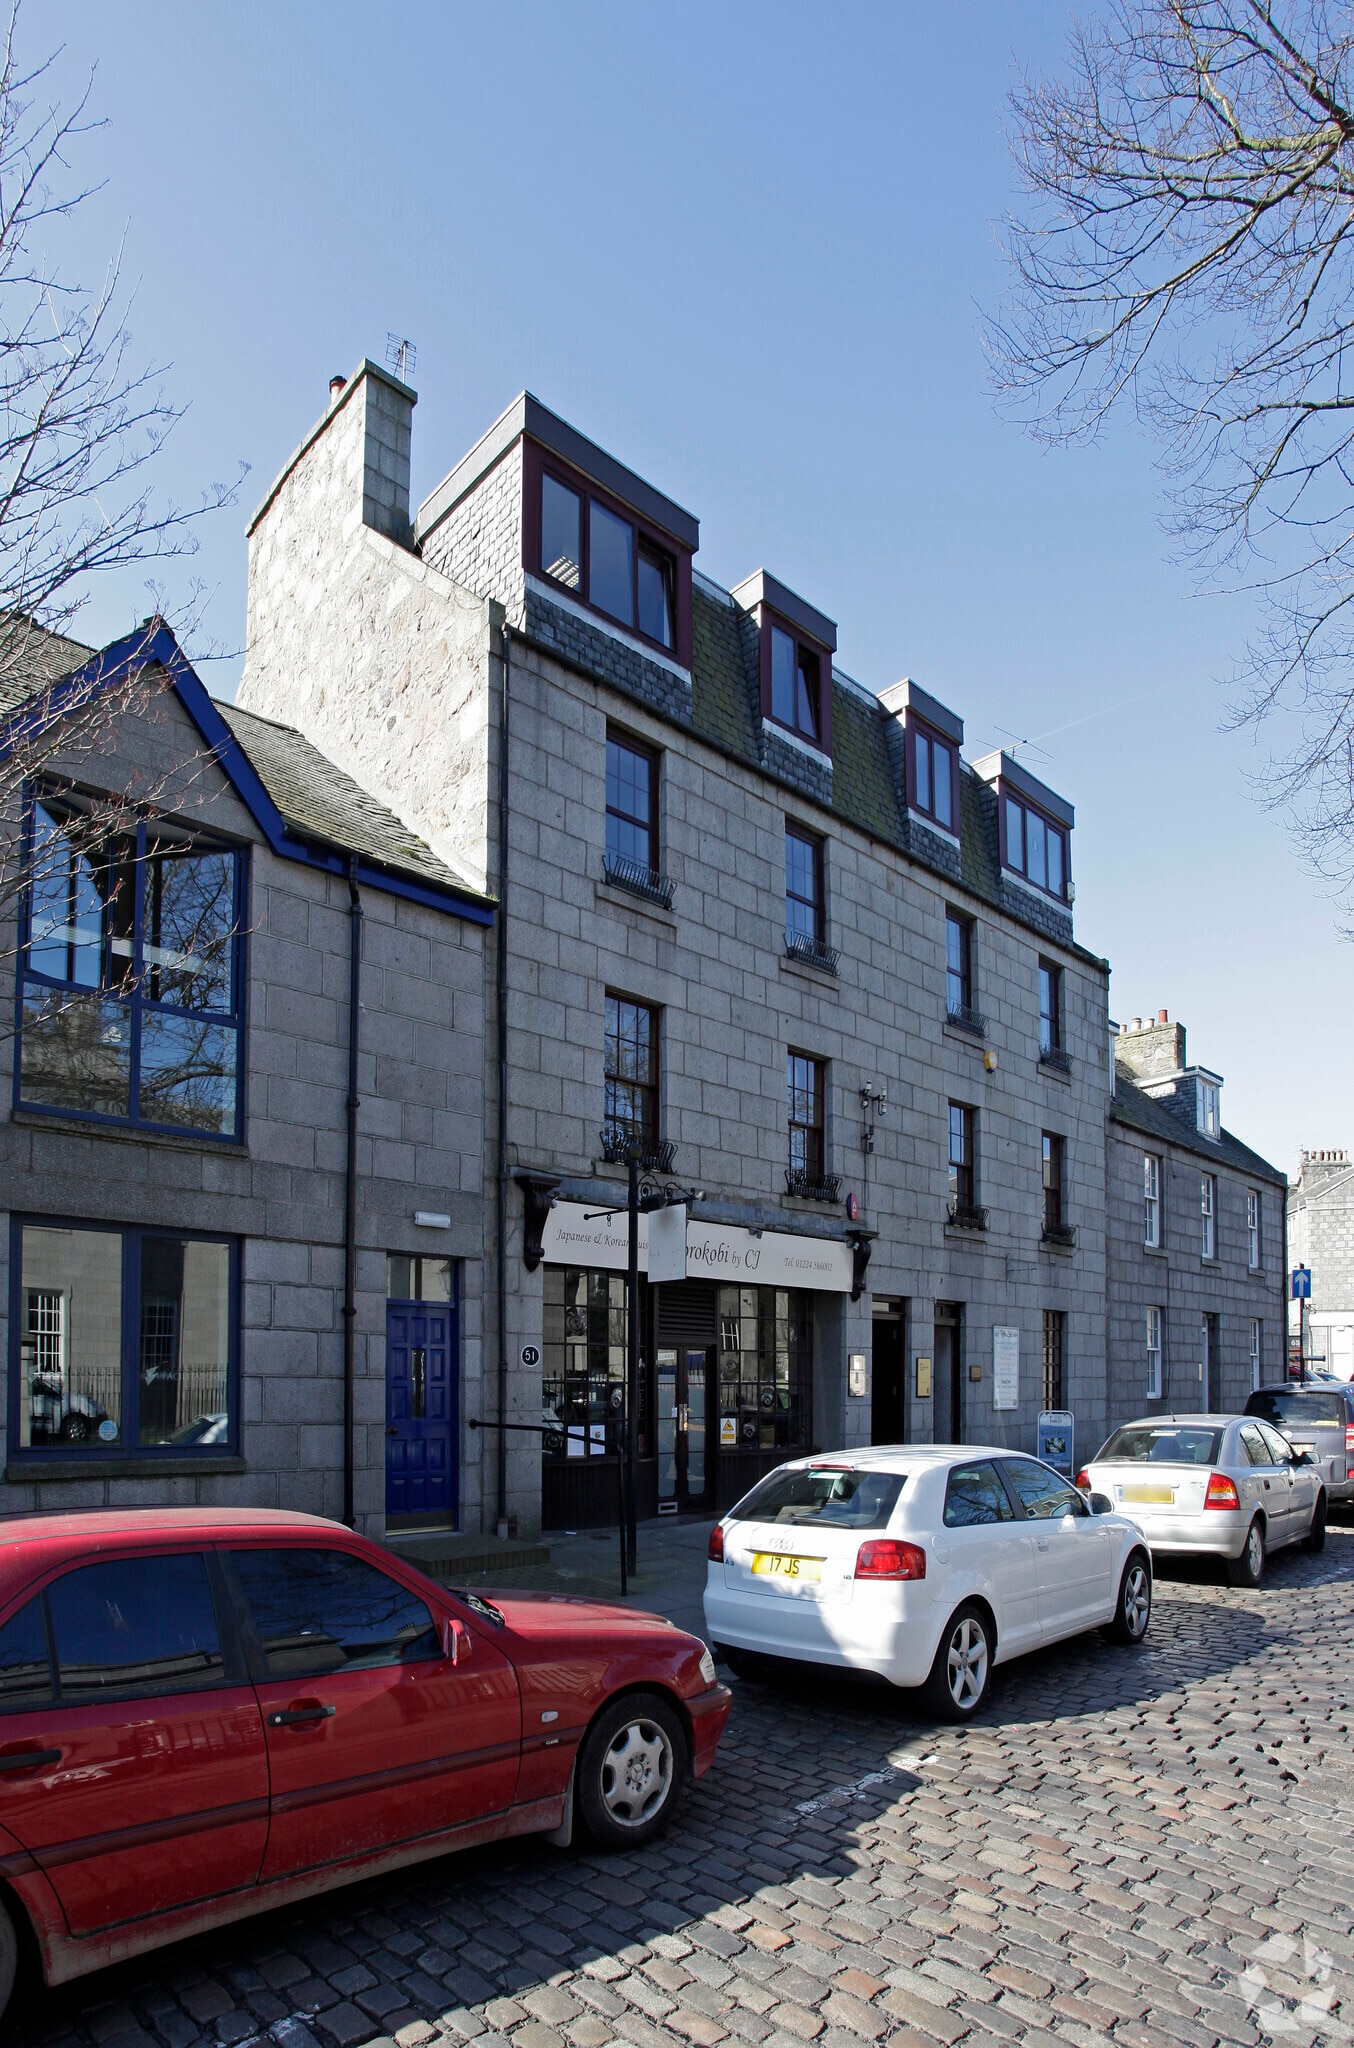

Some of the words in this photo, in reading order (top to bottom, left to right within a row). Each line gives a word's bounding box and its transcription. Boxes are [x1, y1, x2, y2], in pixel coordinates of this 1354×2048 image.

[555, 1228, 592, 1244] Japanese
[593, 1233, 603, 1245] &
[685, 1240, 729, 1266] rokobi
[731, 1250, 742, 1269] by
[745, 1248, 761, 1270] CJ
[795, 1258, 813, 1270] 01224
[525, 1350, 535, 1361] 51
[769, 1556, 782, 1573] 17
[784, 1558, 801, 1575] JS
